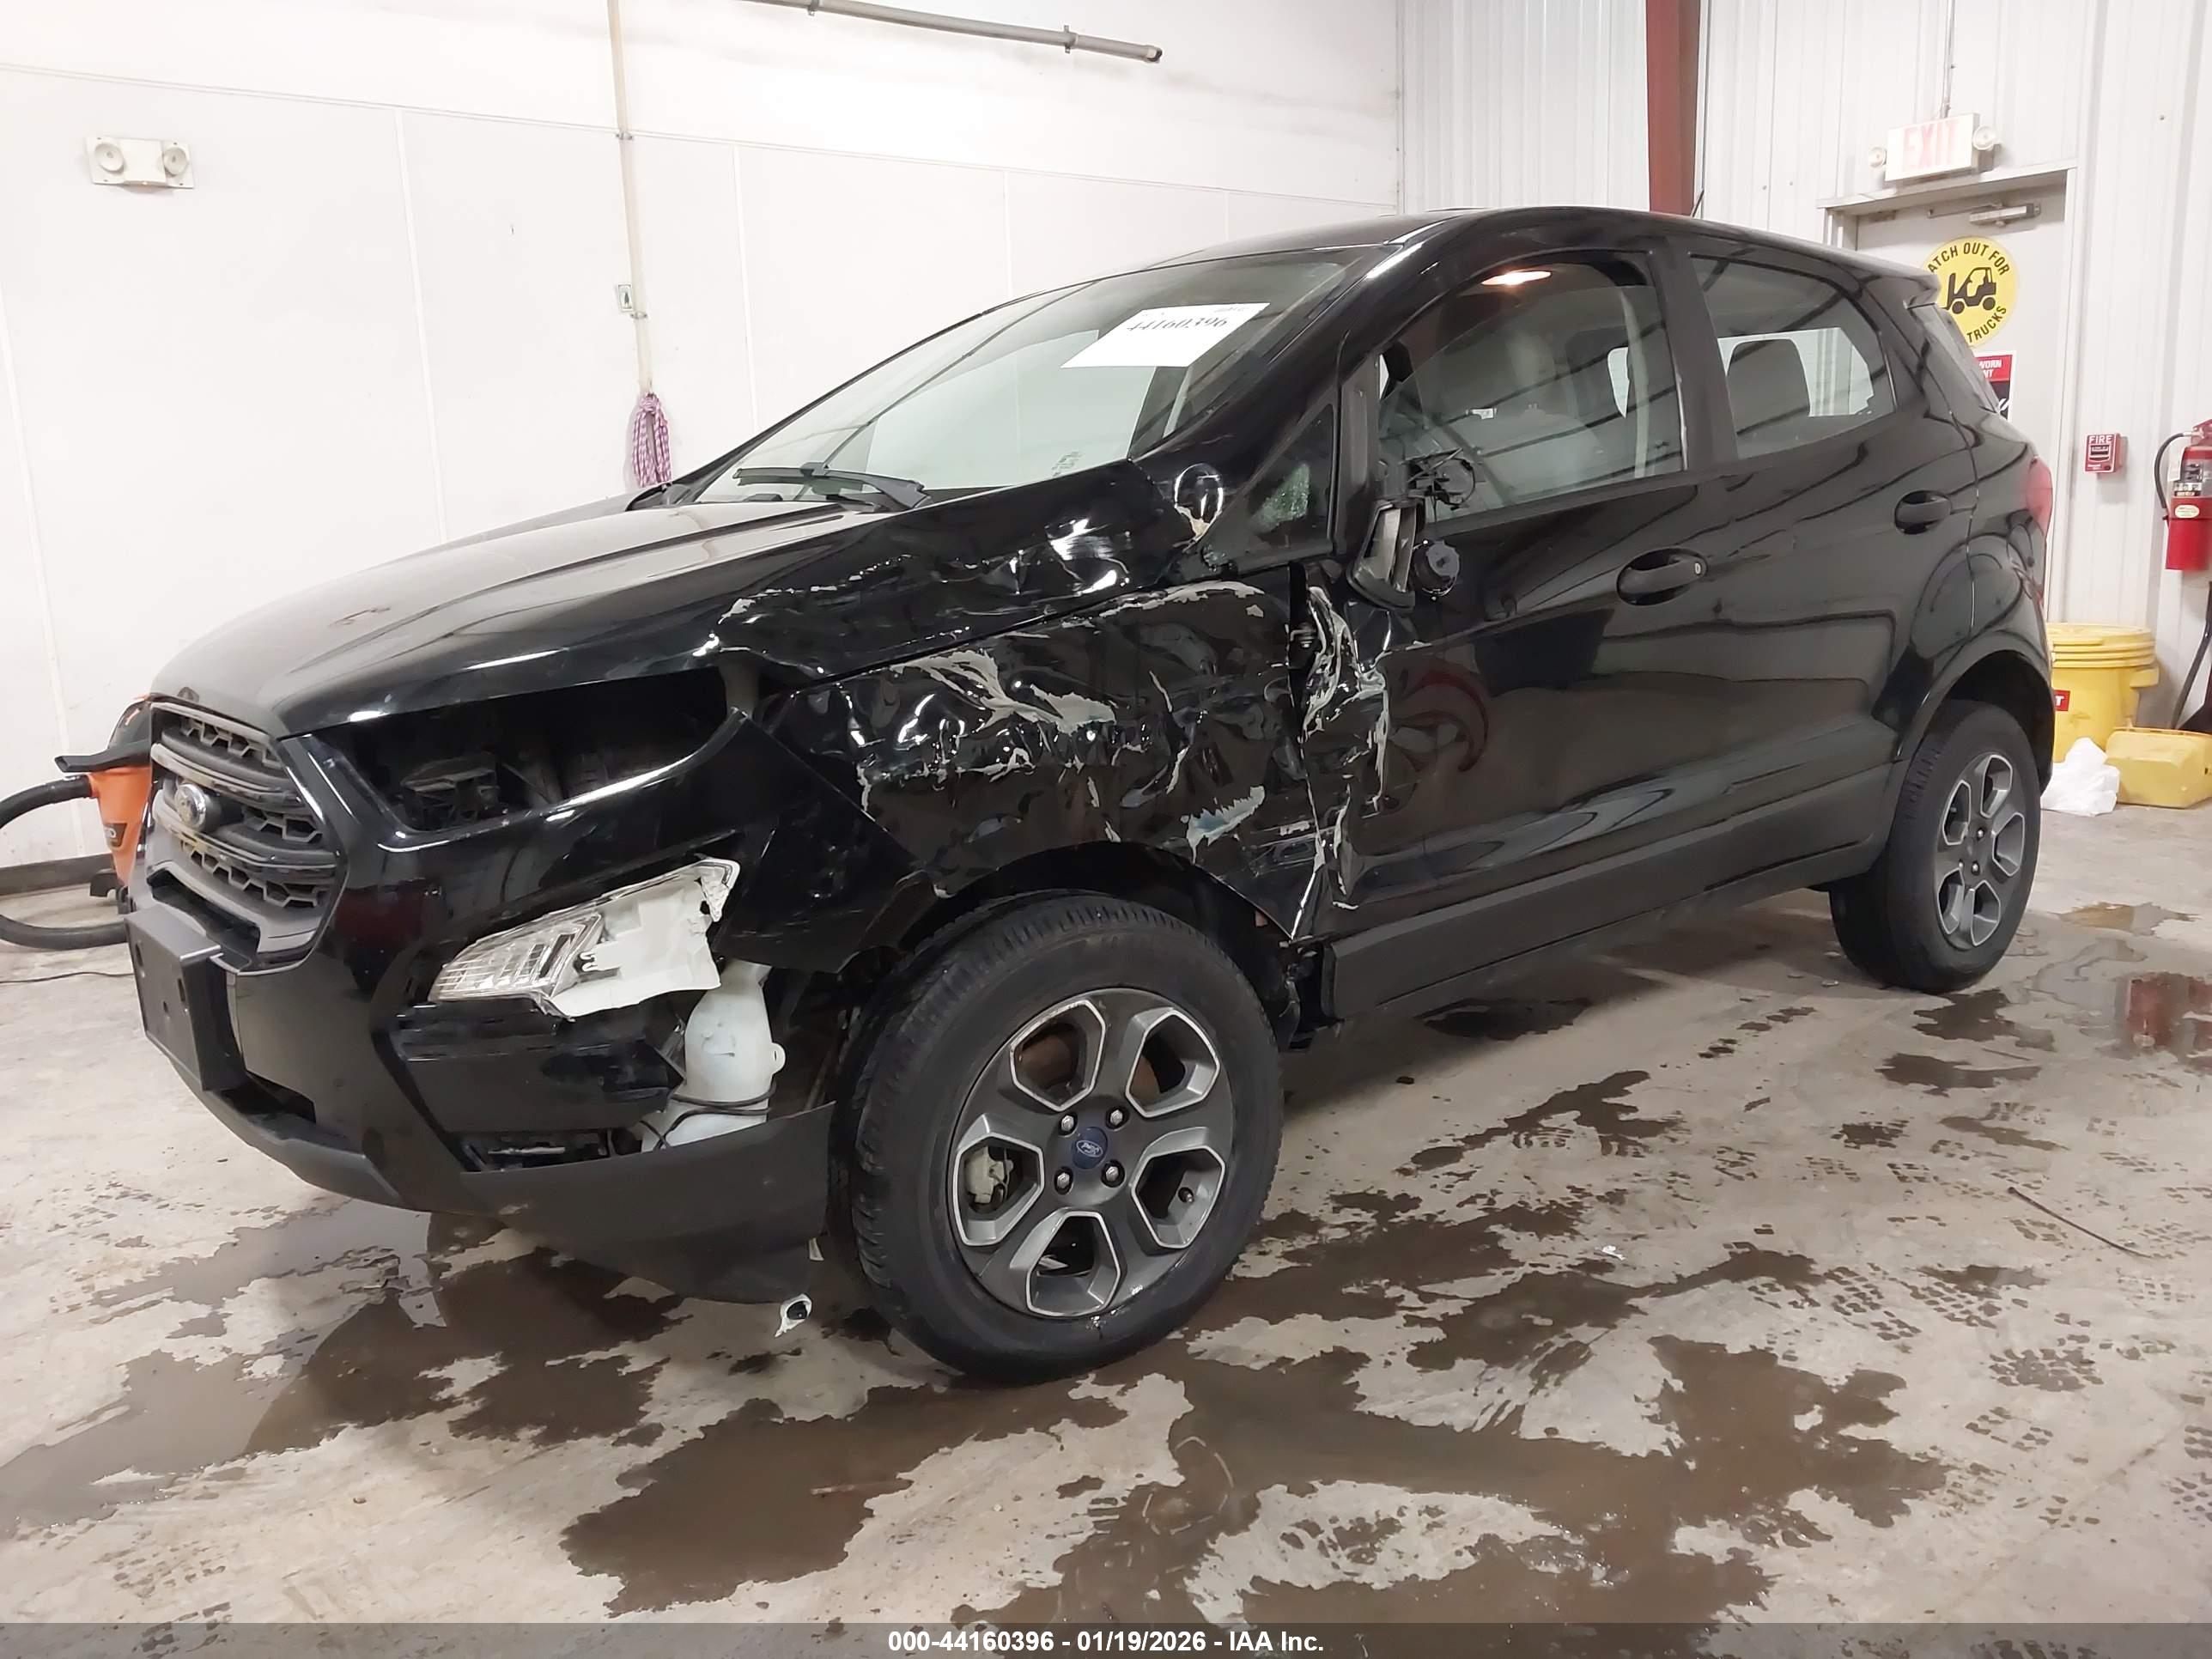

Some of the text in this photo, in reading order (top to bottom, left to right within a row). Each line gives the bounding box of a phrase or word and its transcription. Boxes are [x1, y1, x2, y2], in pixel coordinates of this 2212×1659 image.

[1903, 120, 1959, 172] EXIT
[1928, 242, 2010, 276] ATCH OUT FOR
[1966, 306, 2007, 343] TRUCKS
[2088, 434, 2112, 444] FIRE
